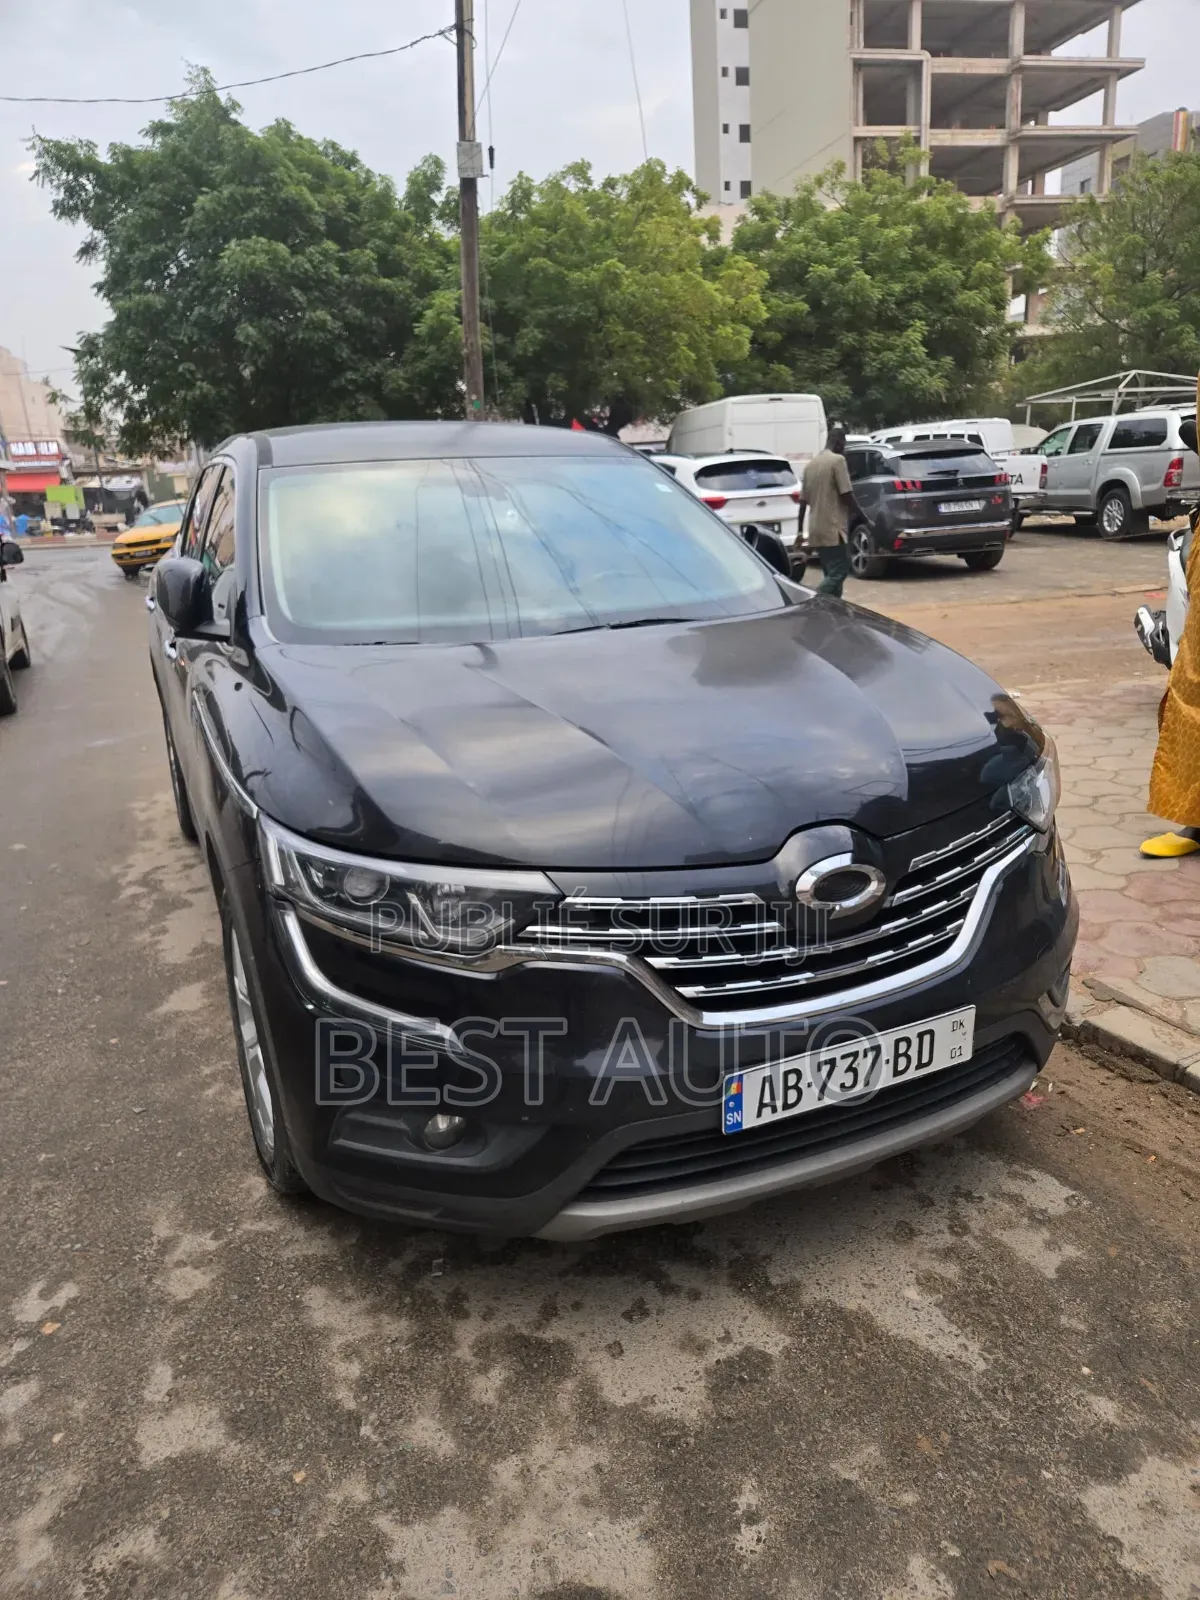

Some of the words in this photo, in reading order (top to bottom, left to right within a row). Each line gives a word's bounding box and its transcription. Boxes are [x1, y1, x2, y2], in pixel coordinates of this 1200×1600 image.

[951, 1018, 966, 1033] DK
[950, 1044, 964, 1060] 01
[725, 1110, 743, 1125] SN
